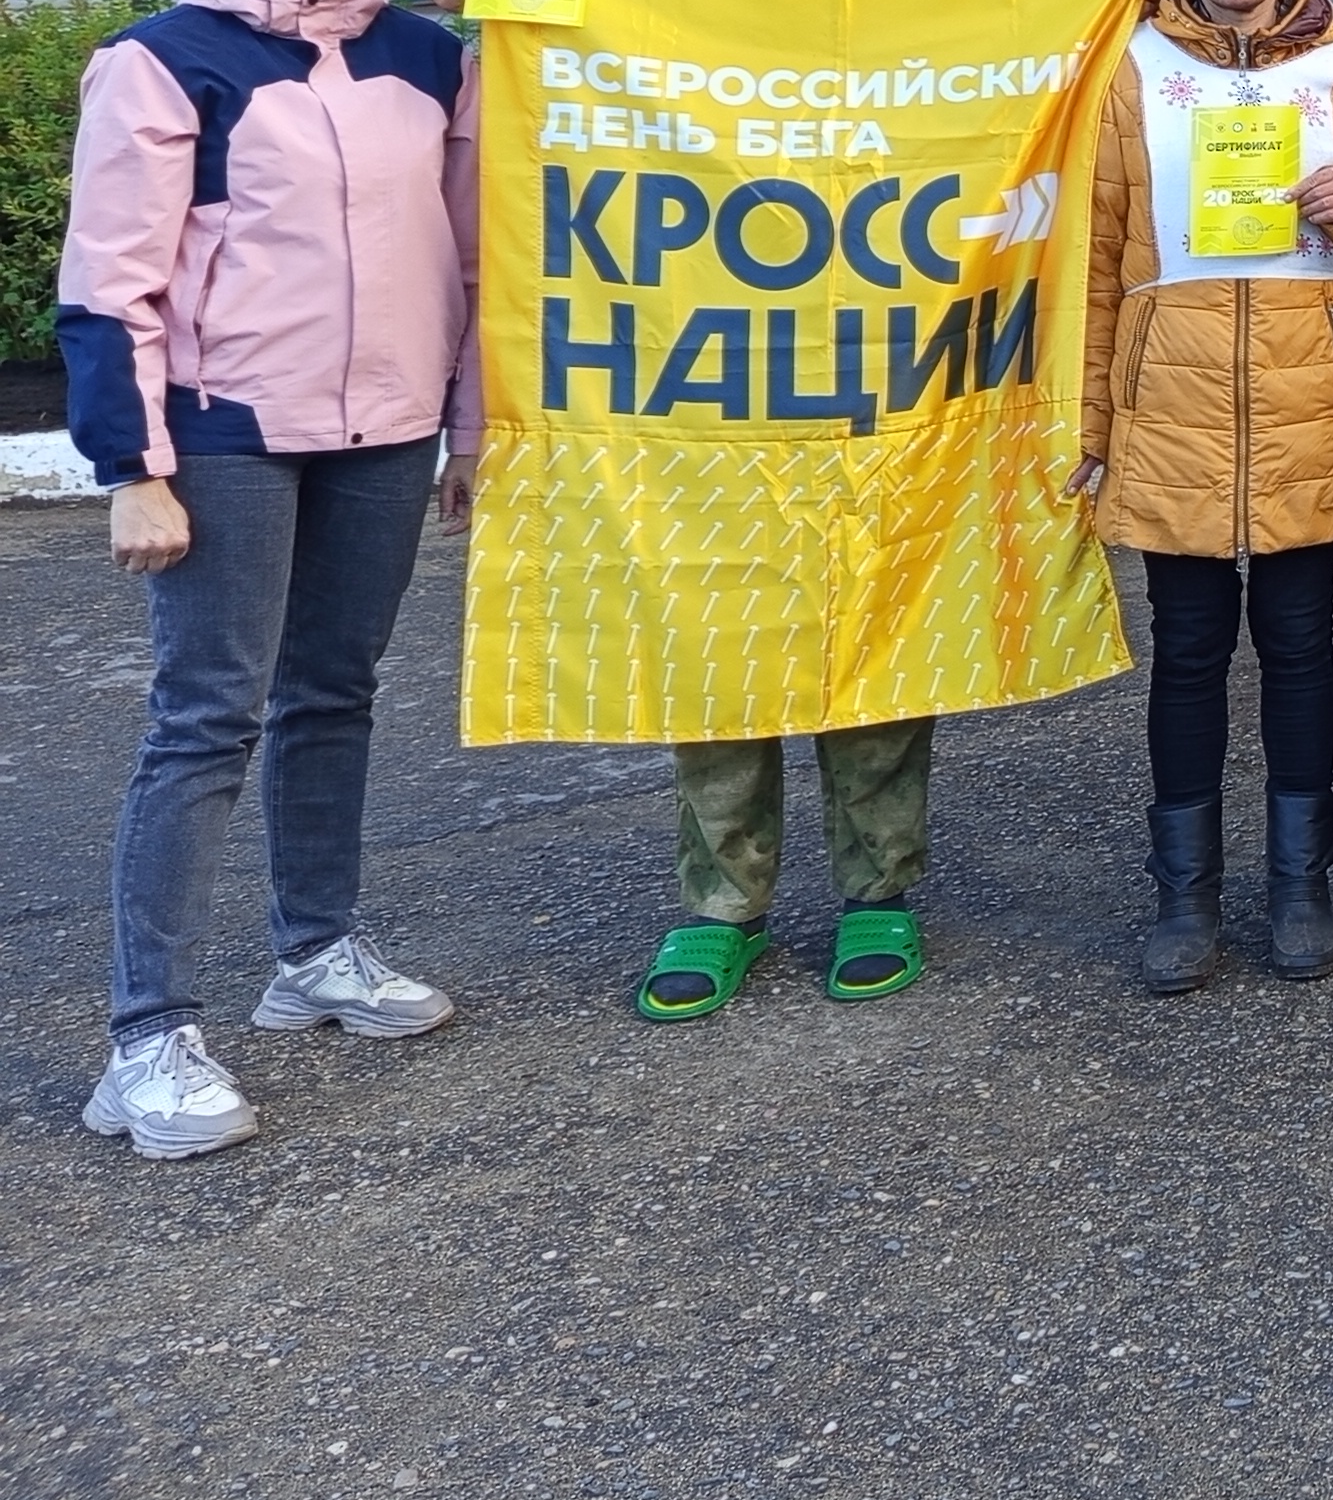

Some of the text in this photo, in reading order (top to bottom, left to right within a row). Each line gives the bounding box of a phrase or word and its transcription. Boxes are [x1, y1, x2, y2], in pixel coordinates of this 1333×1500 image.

[540, 39, 1092, 108] ВСЕРОССИЙСКИЙ
[540, 102, 892, 158] ДЕНЬ БЕГА
[1206, 141, 1282, 152] СЕРТИФИКАТ
[543, 165, 961, 291] КРОСС
[1203, 189, 1232, 207] 20
[542, 277, 1039, 435] НАЦИИ
